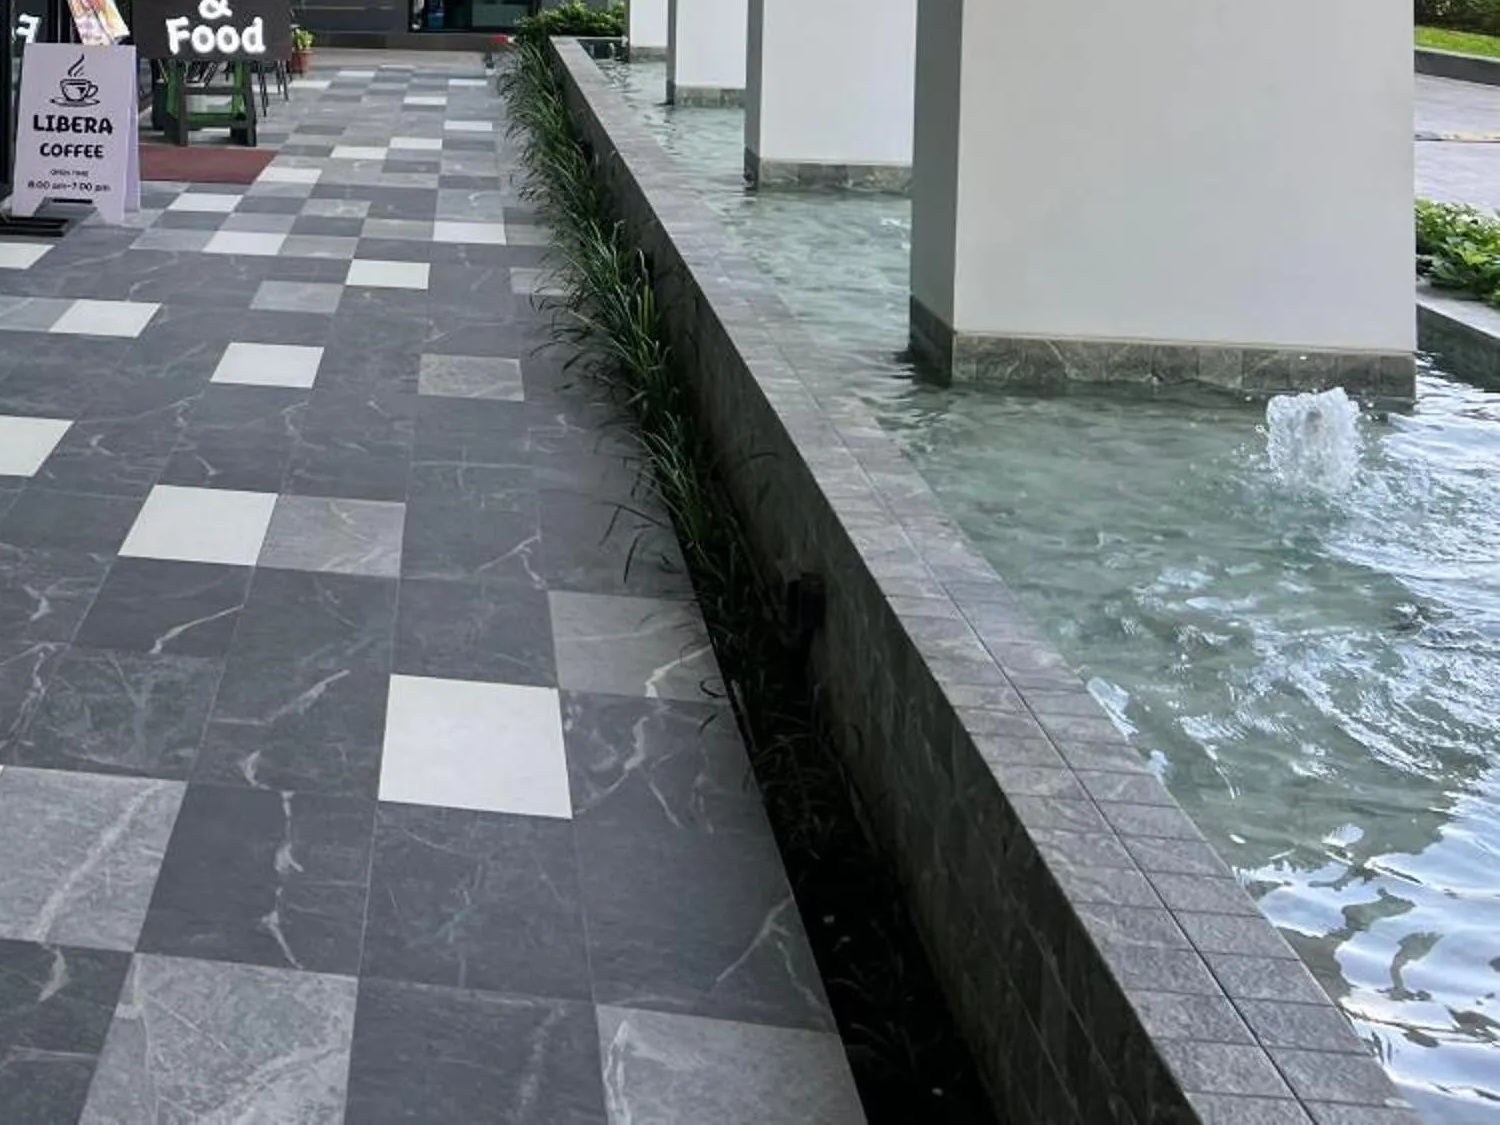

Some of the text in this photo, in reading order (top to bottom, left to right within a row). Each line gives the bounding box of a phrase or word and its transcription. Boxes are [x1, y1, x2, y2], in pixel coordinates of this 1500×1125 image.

[165, 16, 266, 55] Food
[33, 114, 113, 135] LIBERA
[39, 142, 105, 158] COFFEE
[50, 168, 71, 176] OPEN
[94, 183, 111, 193] pm
